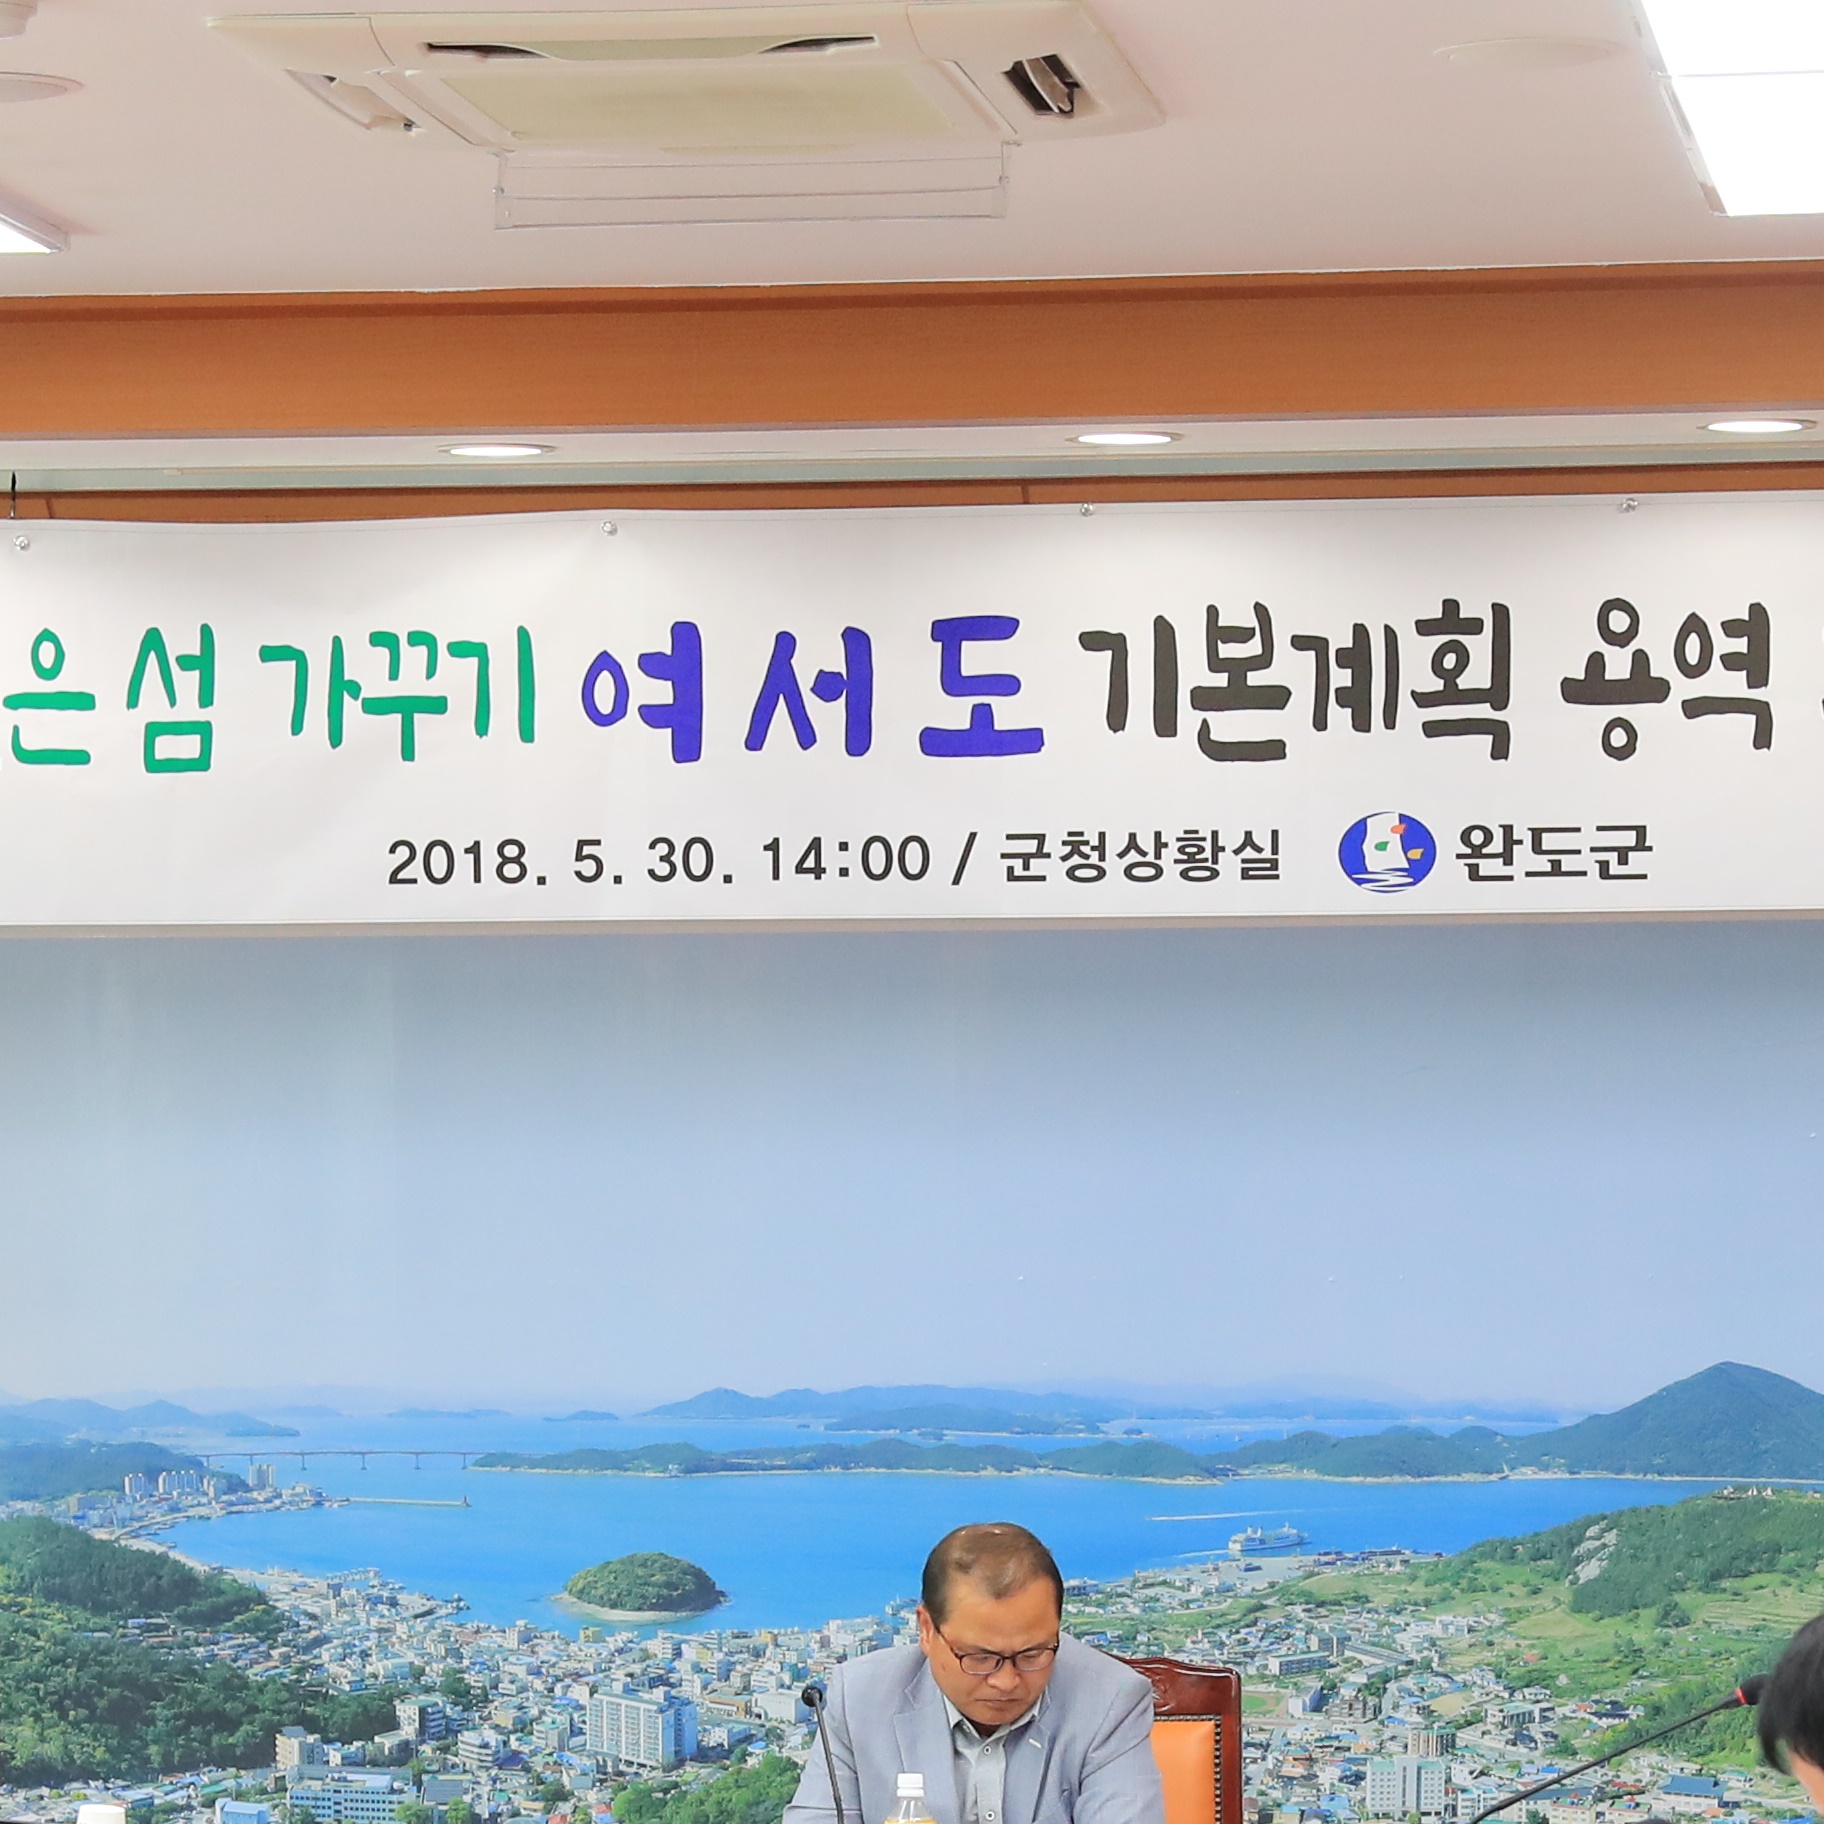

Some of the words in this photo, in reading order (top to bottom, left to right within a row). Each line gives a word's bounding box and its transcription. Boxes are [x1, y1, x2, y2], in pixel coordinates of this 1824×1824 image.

[126, 622, 216, 773] 섬
[259, 624, 536, 763] 가꾸기
[1078, 598, 1512, 763] 기본계획
[1560, 597, 1774, 762] 용역
[389, 838, 547, 885] 2018.
[573, 838, 623, 885] 5.
[647, 837, 733, 885] 30.
[762, 835, 931, 883] 14:00
[1000, 829, 1281, 884] 군청상황실
[1455, 823, 1655, 882] 완도군
